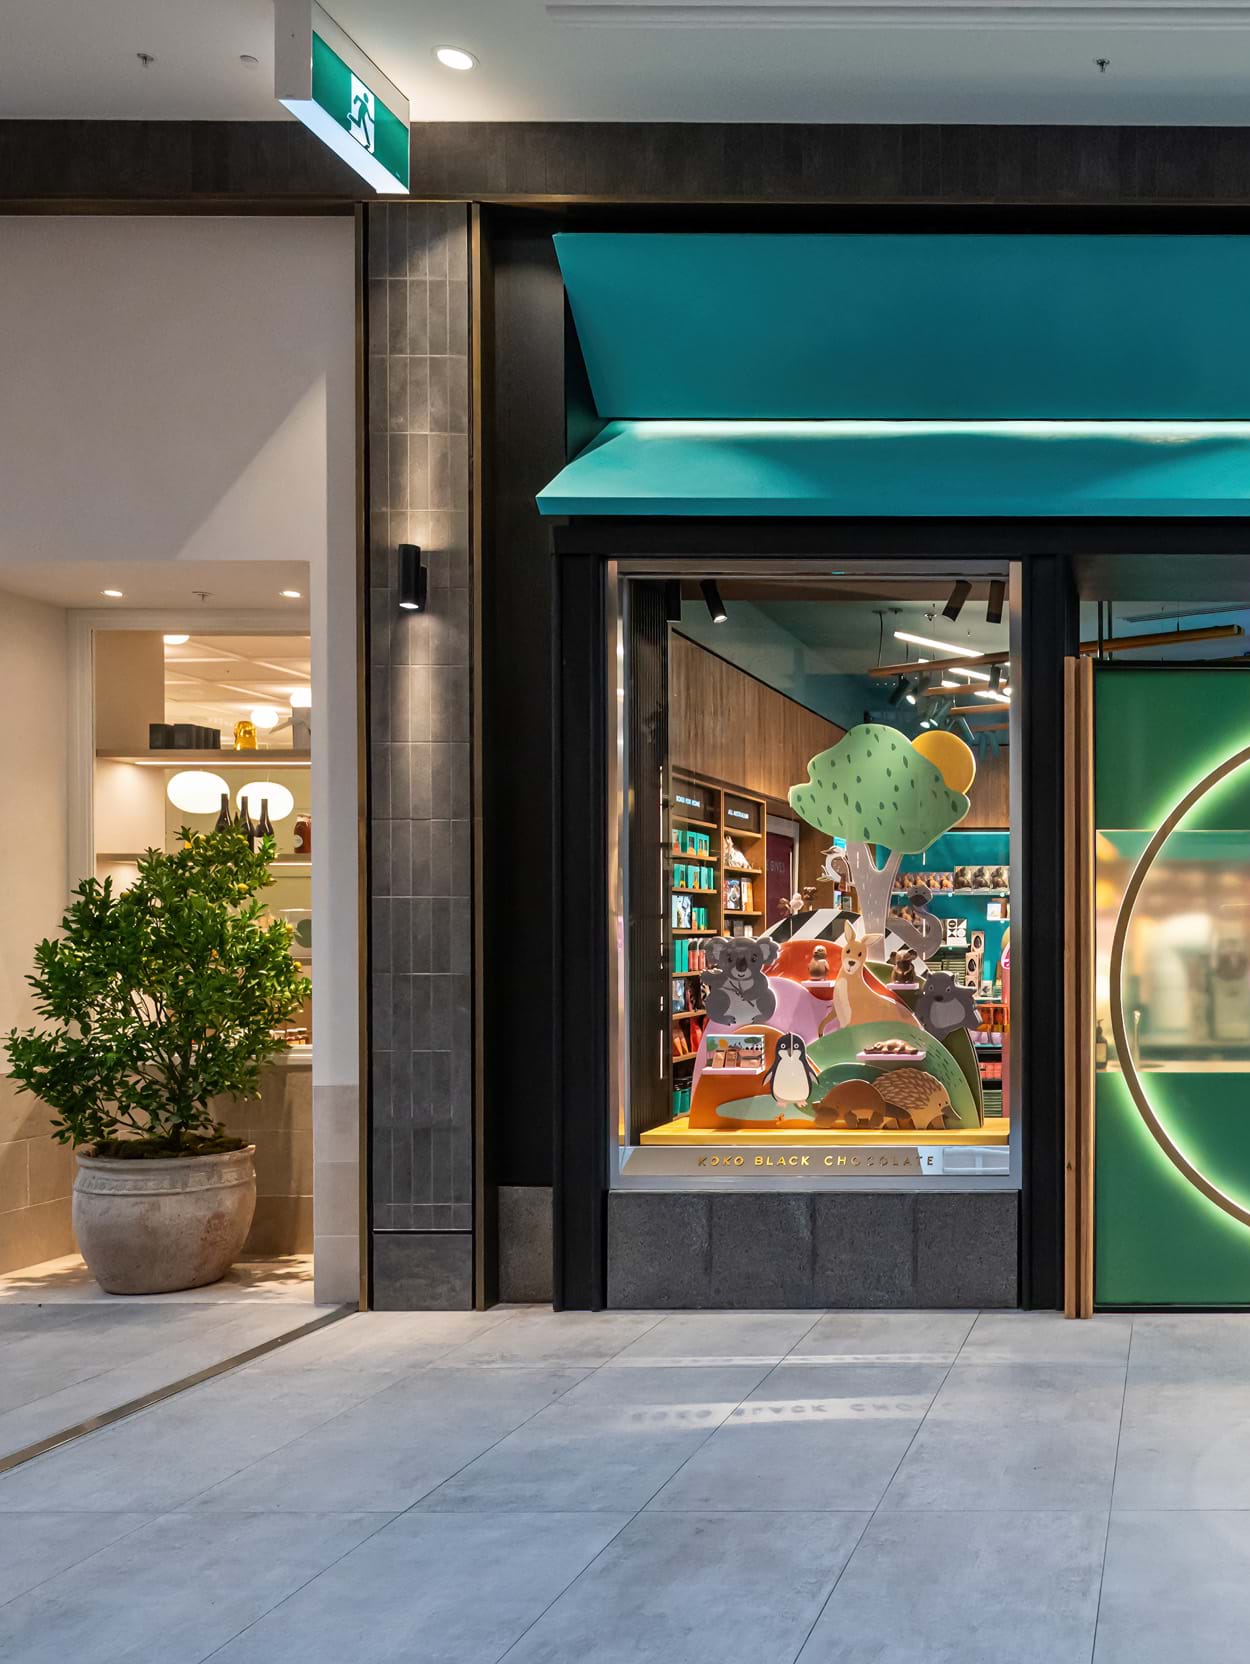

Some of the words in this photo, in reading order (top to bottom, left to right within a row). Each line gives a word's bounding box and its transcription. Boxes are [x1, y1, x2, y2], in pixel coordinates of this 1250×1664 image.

[697, 1155, 745, 1167] KOKO
[754, 1155, 810, 1167] BLACK
[823, 1155, 934, 1167] CHOCOLATE
